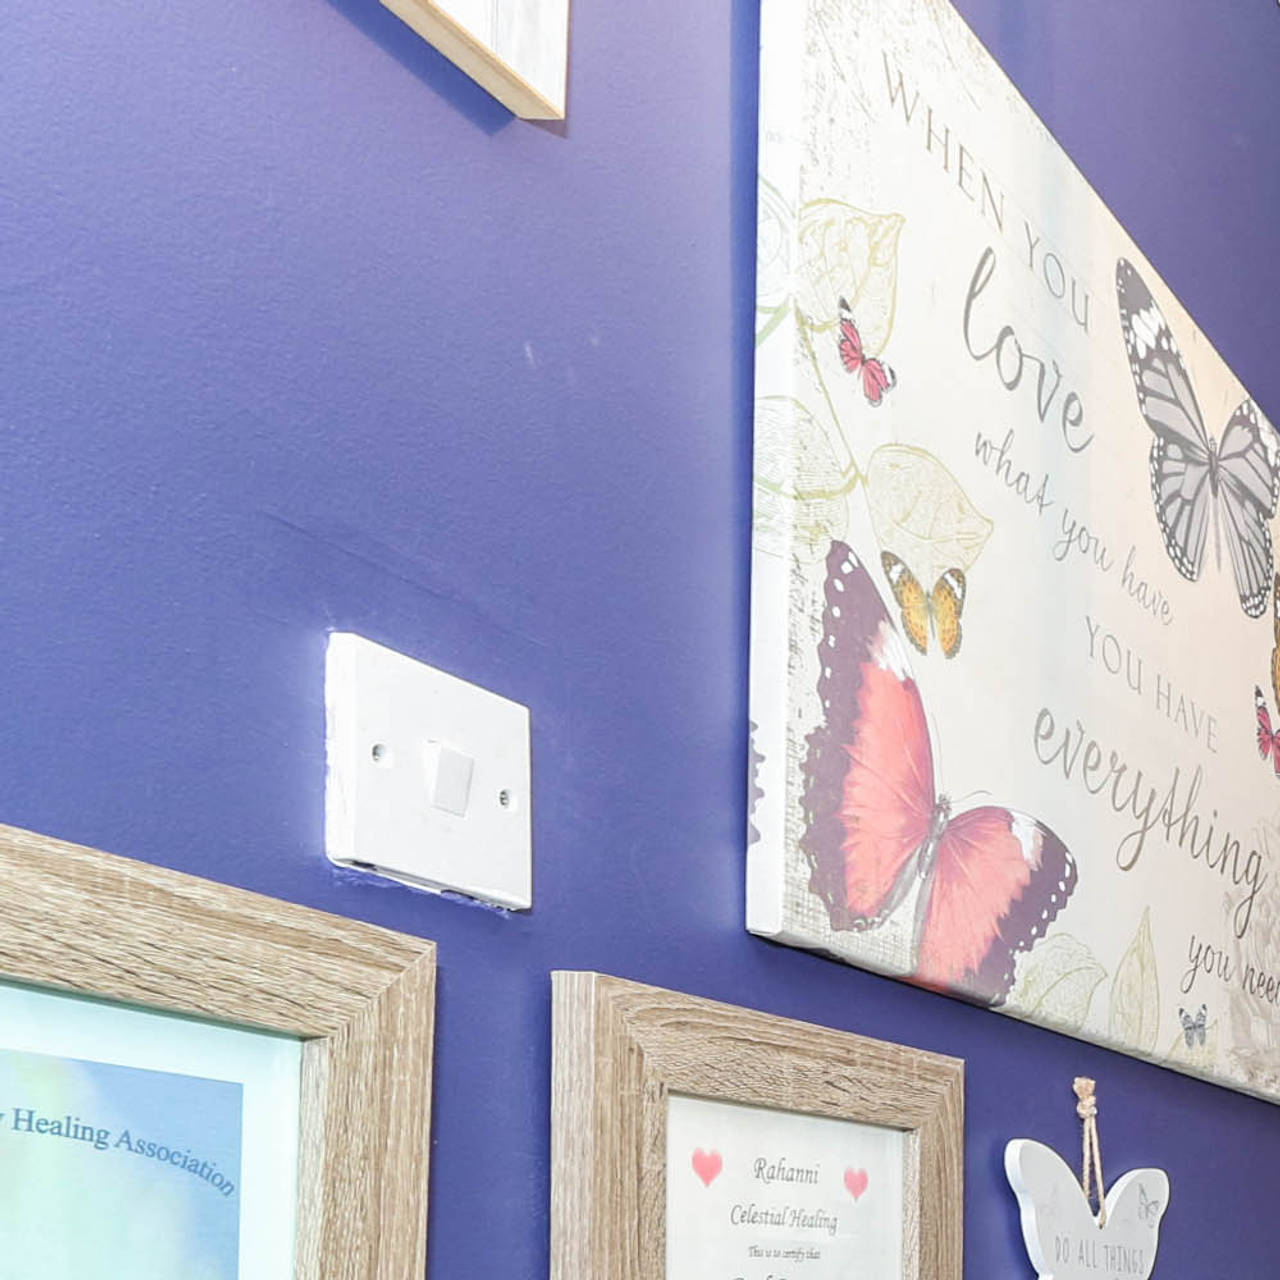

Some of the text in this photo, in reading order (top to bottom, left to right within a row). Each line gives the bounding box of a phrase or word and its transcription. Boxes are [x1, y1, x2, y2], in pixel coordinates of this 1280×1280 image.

[882, 48, 1091, 334] WHEN YOU
[962, 247, 1095, 453] love
[974, 428, 1174, 626] what you have
[1085, 615, 1218, 753] YOU HAVE
[1033, 706, 1268, 938] everything
[1180, 934, 1236, 995] you
[11, 1107, 236, 1197] Healing Association
[753, 1156, 821, 1185] Rahanni
[730, 1203, 839, 1236] Celestial Healing
[1055, 1235, 1147, 1275] DO ALL THINGS
